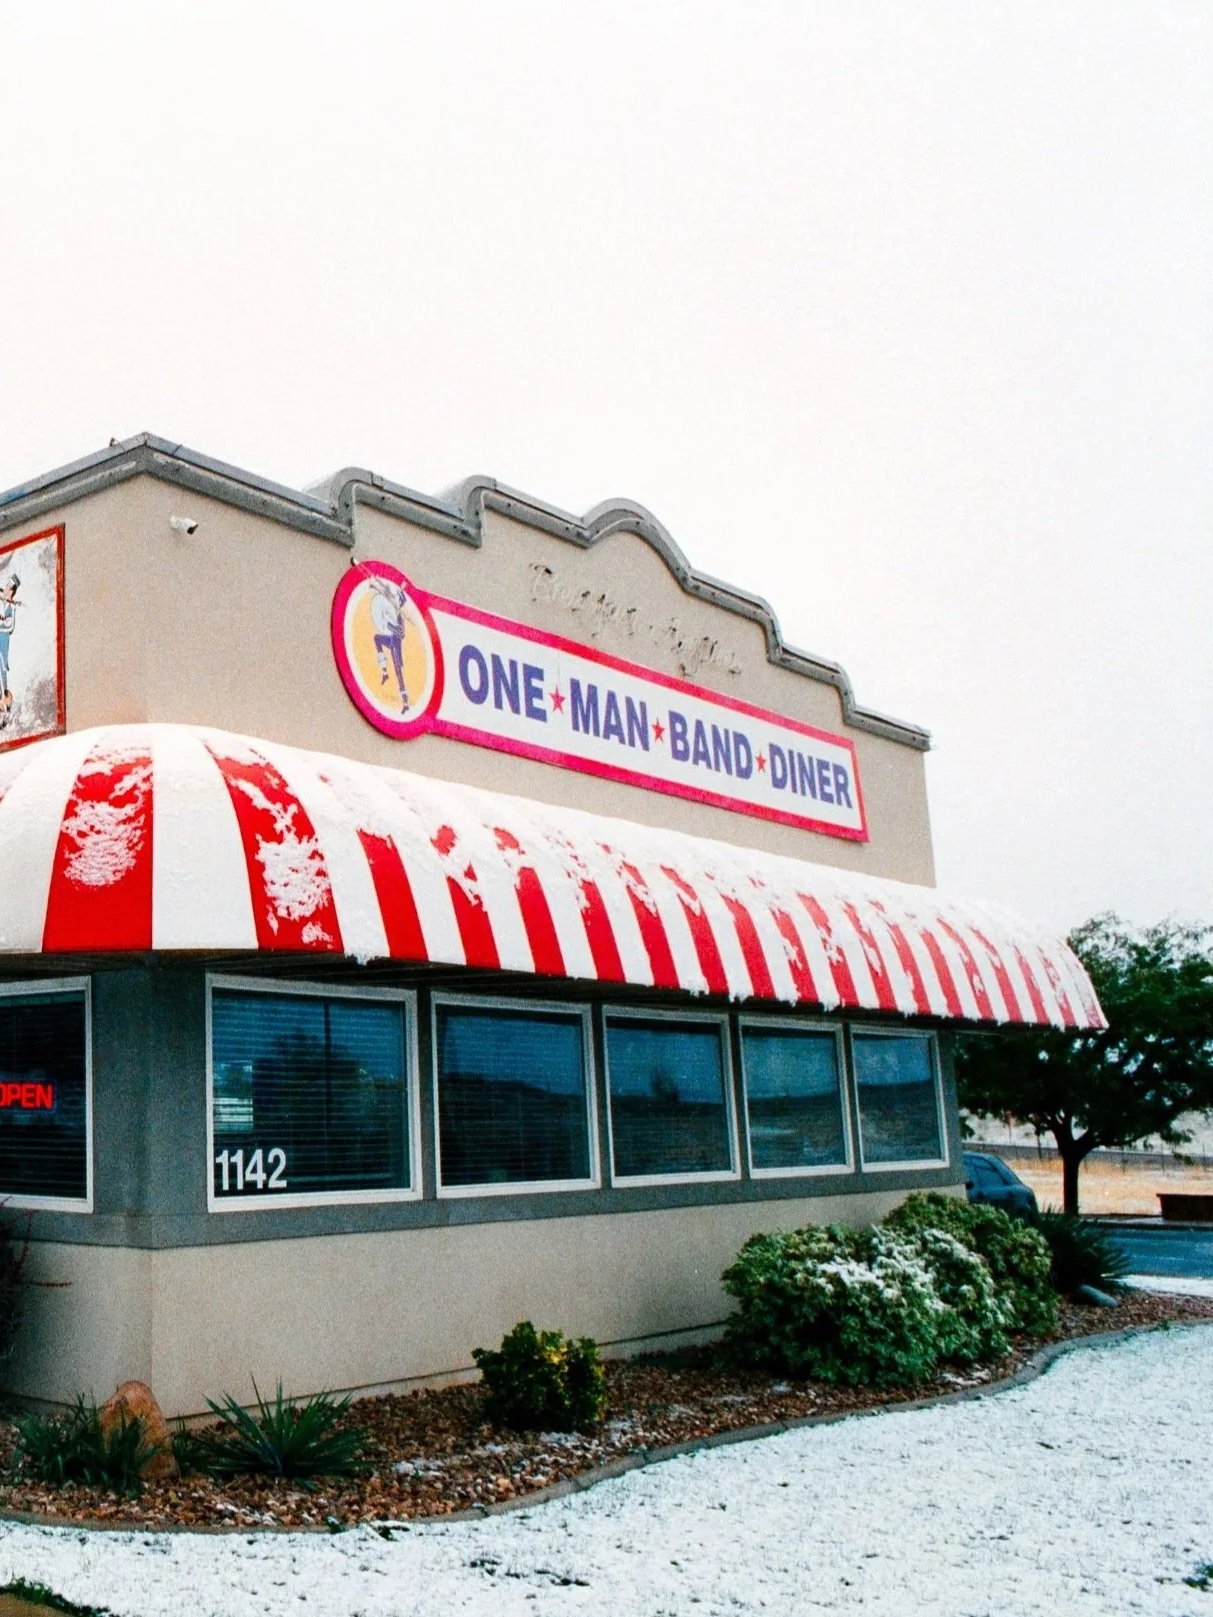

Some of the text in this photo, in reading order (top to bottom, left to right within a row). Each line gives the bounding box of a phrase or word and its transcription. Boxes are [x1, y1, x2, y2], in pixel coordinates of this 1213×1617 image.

[458, 644, 854, 809] ONE MAN BAND DINER
[215, 1147, 287, 1191] 1142
